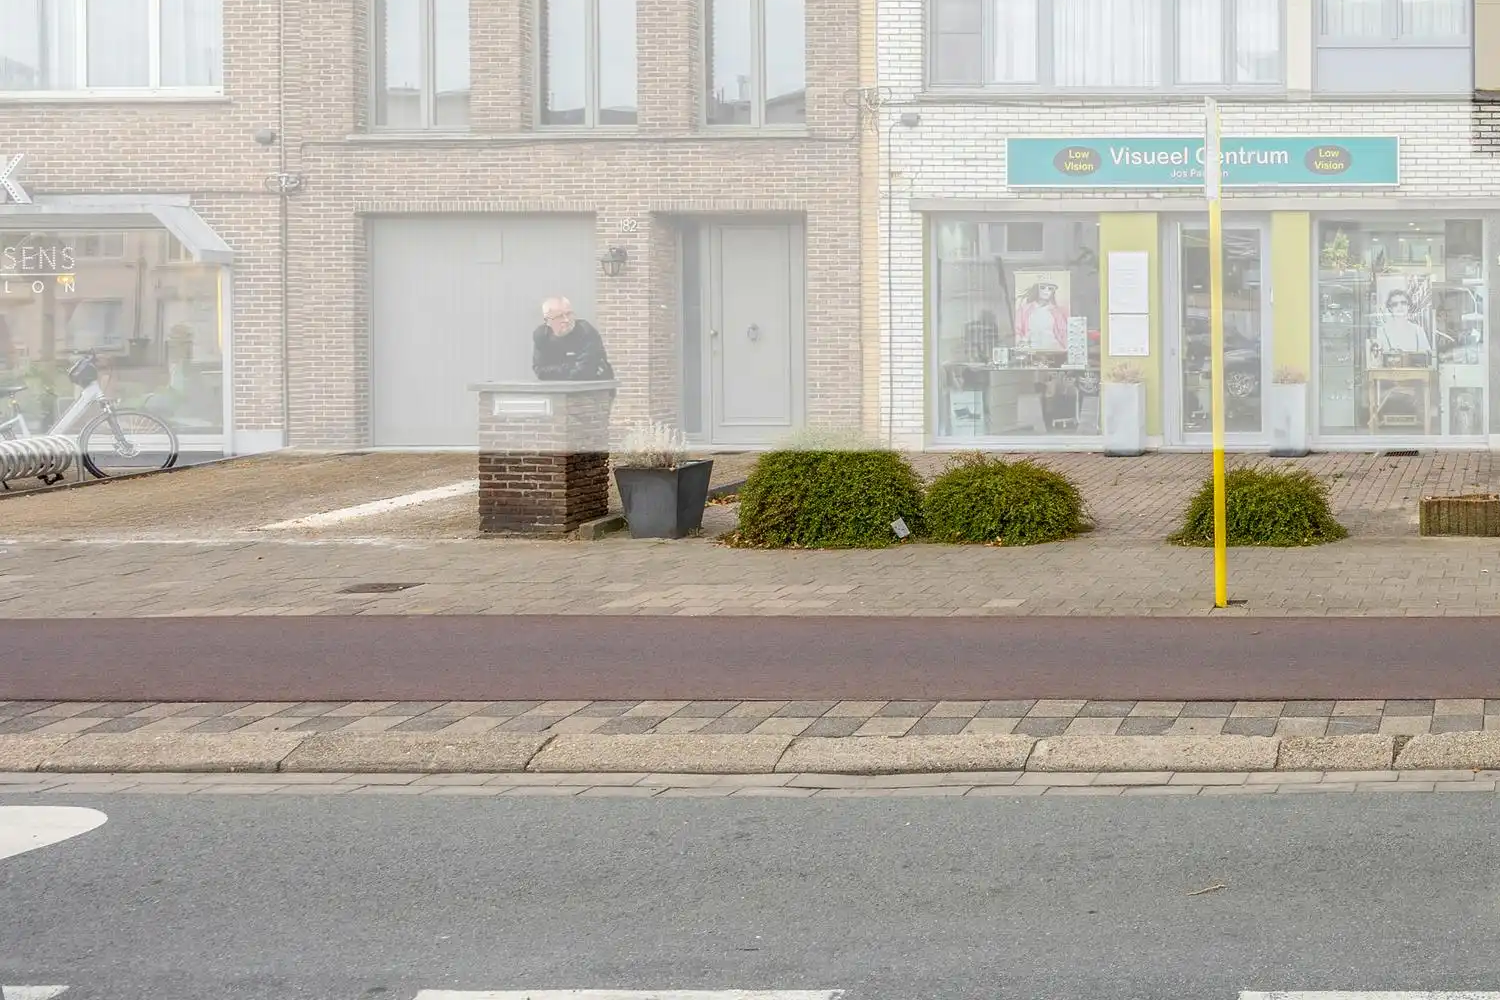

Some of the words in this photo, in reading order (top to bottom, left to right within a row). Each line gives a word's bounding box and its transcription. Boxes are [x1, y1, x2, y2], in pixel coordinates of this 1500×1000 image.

[1068, 149, 1090, 159] Low
[1109, 146, 1188, 165] Visueel
[1319, 148, 1341, 158] Low
[1063, 160, 1094, 171] Vision
[1314, 160, 1345, 170] Vision
[1170, 168, 1188, 178] Jos
[620, 218, 637, 233] 182
[3, 246, 76, 270] SENS
